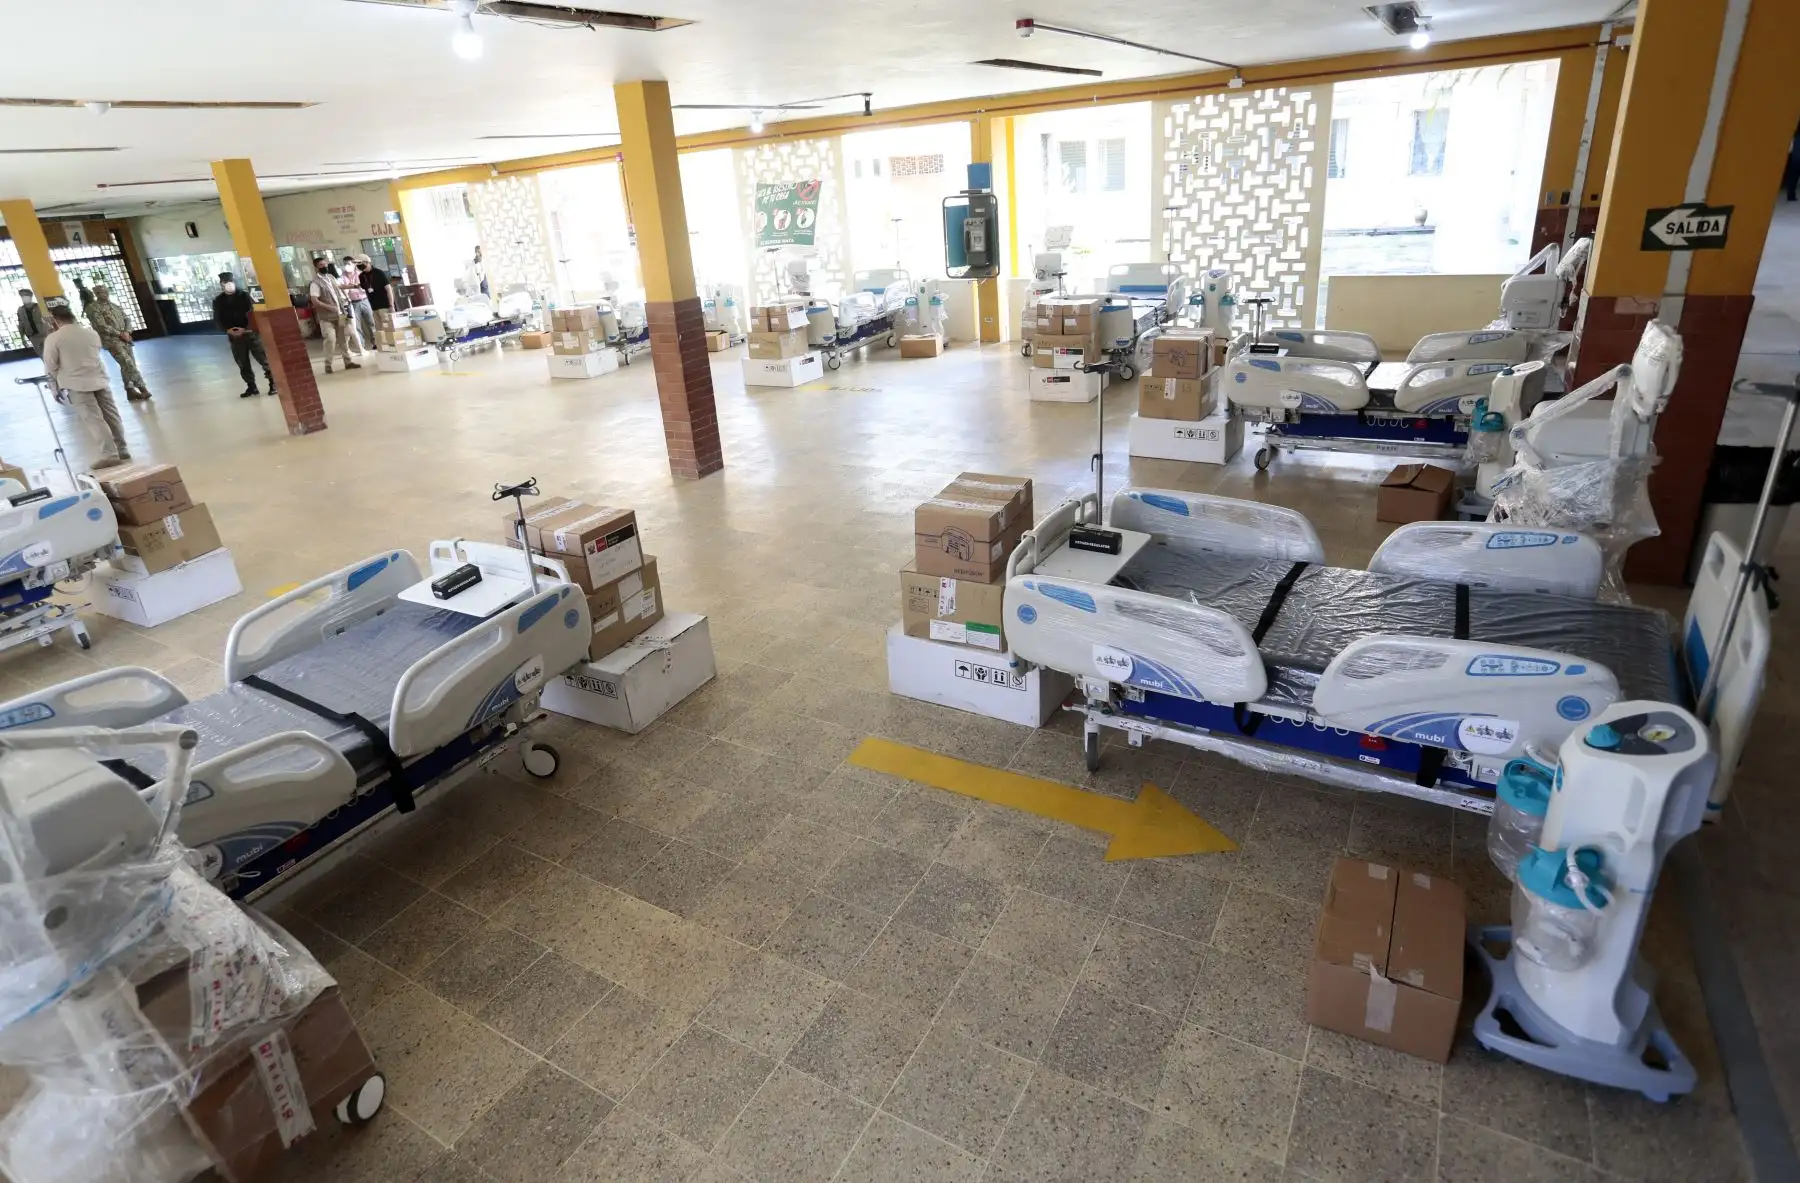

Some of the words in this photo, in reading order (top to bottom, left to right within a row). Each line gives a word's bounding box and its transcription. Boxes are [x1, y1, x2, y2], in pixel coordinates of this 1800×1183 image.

[371, 223, 394, 237] CAJA
[1665, 220, 1720, 235] SALIDA
[73, 231, 82, 245] 4
[1140, 678, 1163, 689] mubi
[1415, 731, 1445, 744] mubi
[236, 842, 264, 864] mubi
